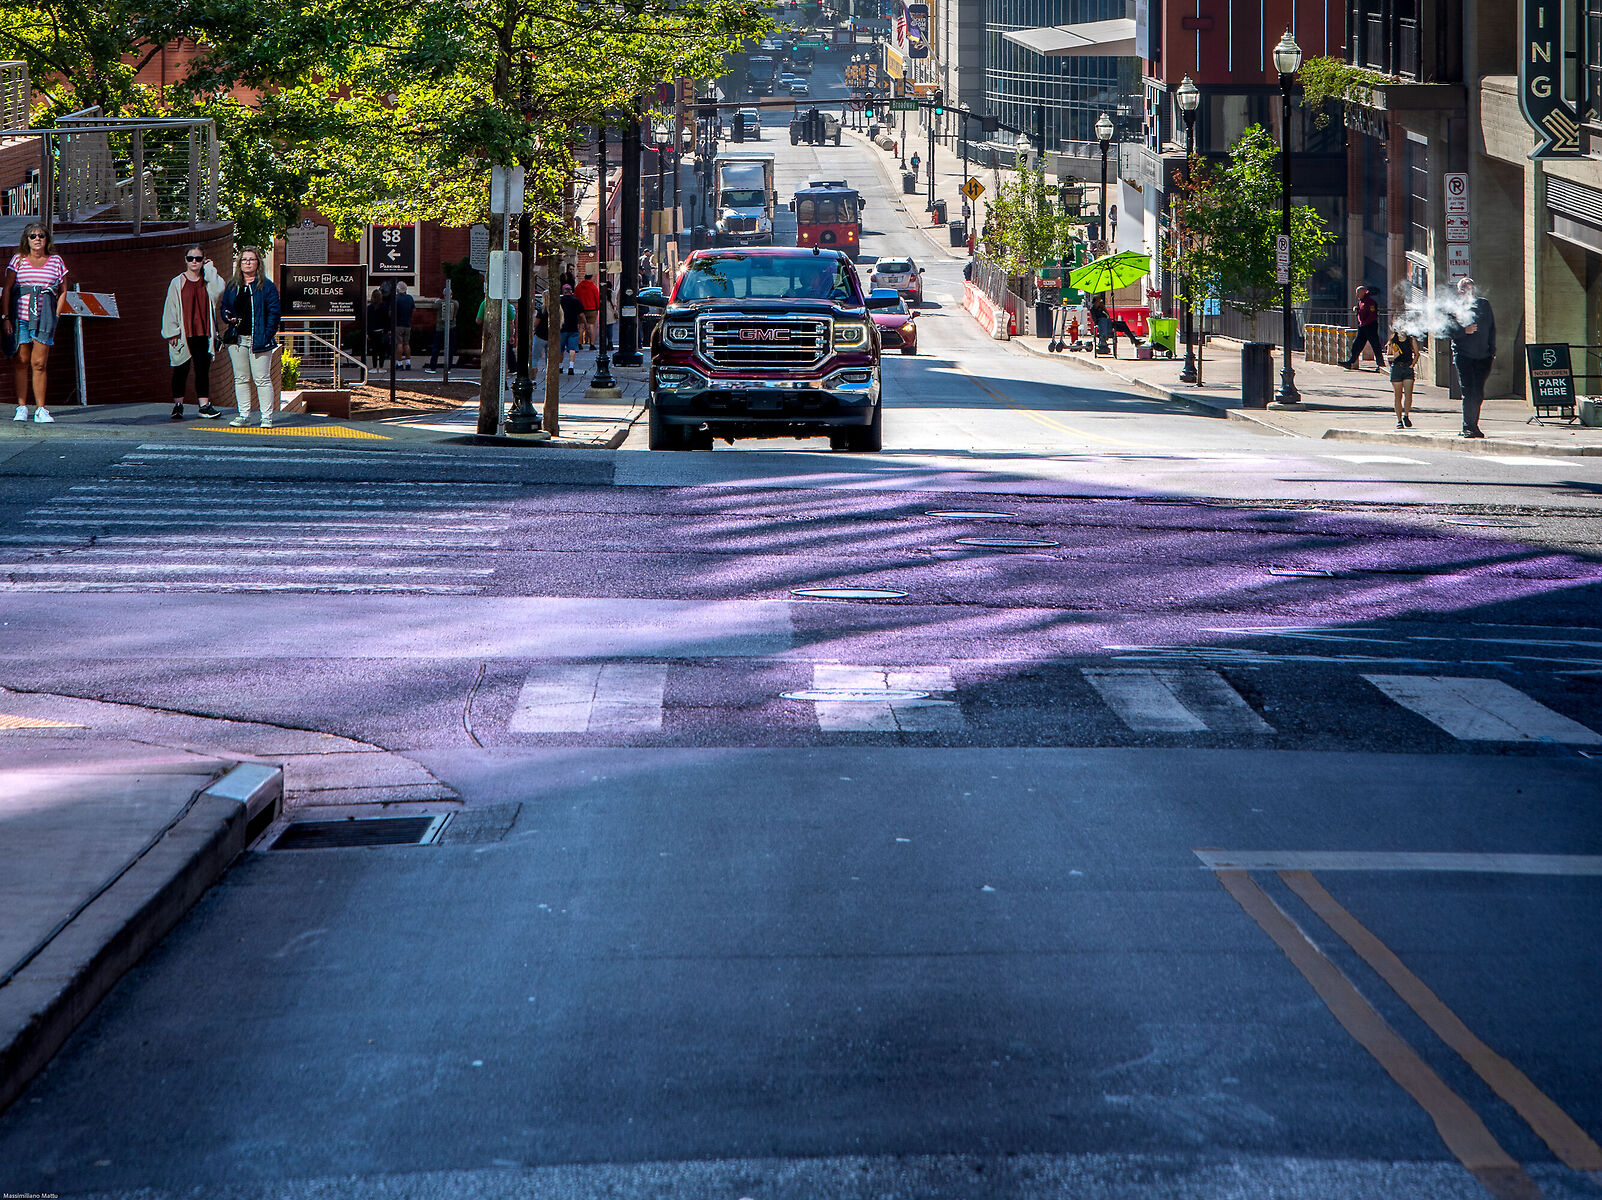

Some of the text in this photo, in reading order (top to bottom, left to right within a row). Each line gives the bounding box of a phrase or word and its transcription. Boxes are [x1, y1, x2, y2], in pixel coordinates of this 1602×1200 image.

[892, 100, 916, 110] Broadway
[8, 182, 32, 216] TRUIST
[381, 229, 401, 243] $8
[293, 275, 354, 283] TRUIST PLAZA
[303, 287, 344, 295] FOR LEASE
[740, 329, 790, 340] GMC
[1538, 378, 1567, 387] PARK
[1540, 387, 1567, 396] HERE
